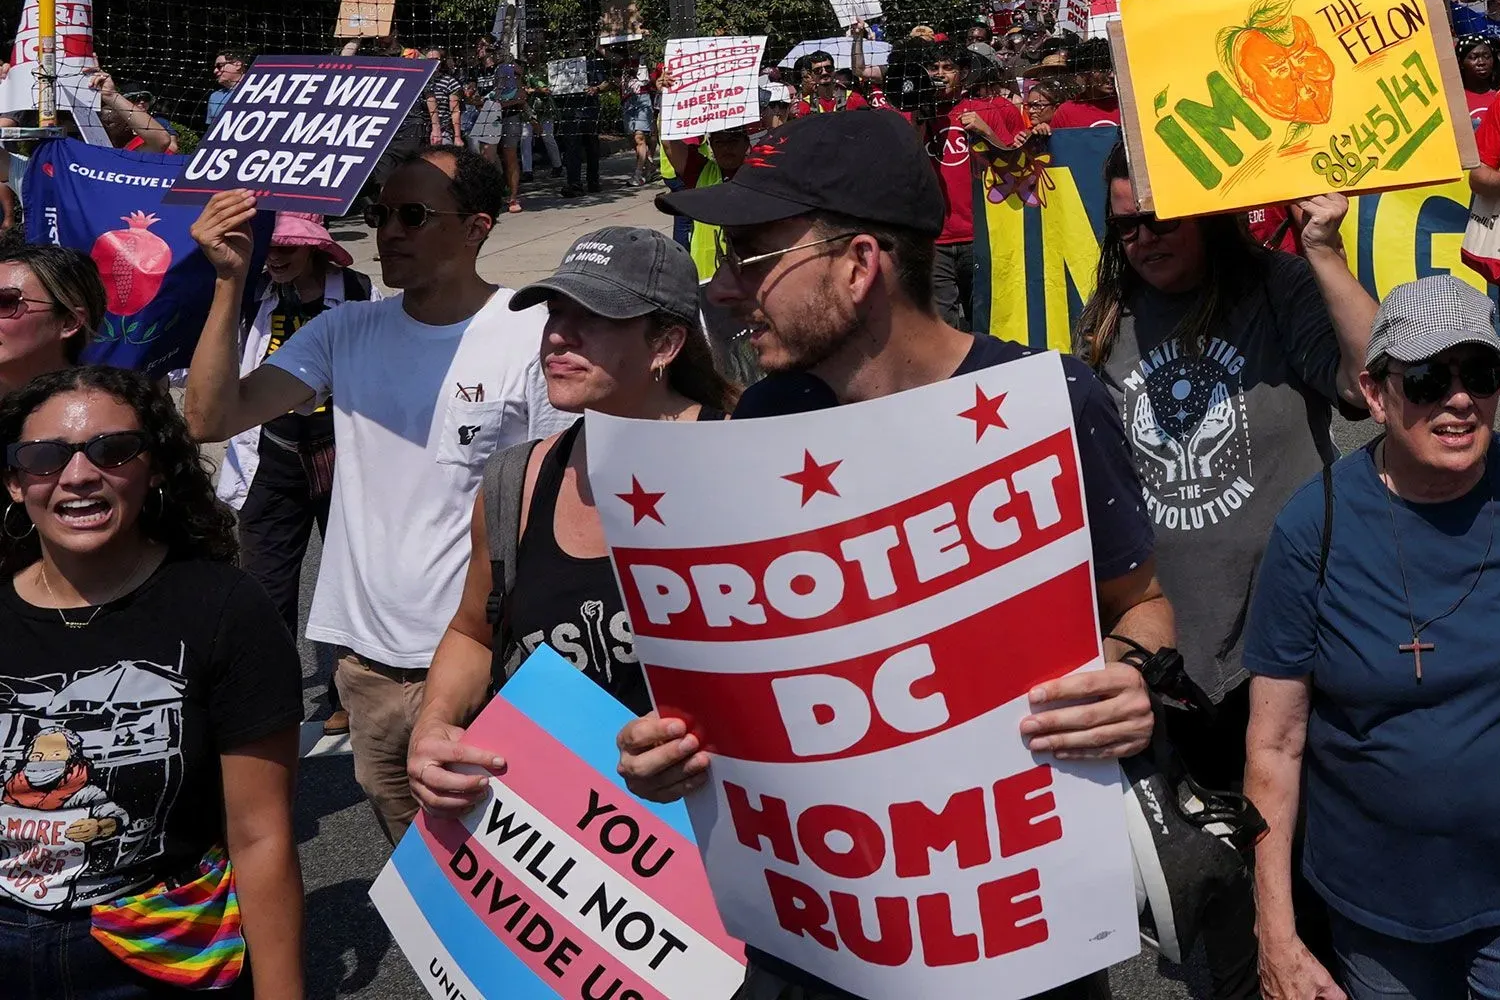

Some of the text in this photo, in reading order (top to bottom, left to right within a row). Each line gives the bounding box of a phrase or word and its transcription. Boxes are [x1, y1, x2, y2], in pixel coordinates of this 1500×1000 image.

[1067, 10, 1087, 31] RUL
[669, 44, 760, 69] TENEMOS
[232, 73, 406, 110] HATE WILL
[677, 85, 745, 111] LIBERTAD
[207, 110, 391, 149] NOT MAKE
[675, 105, 746, 129] SEGURIDAD
[68, 162, 158, 188] COLLECTIVE
[184, 148, 366, 189] US GREAT
[1178, 483, 1201, 500] THE
[628, 453, 1064, 629] PROTECT
[771, 642, 950, 757] DC
[6, 816, 67, 847] MORE
[575, 788, 676, 878] YOU
[721, 763, 1064, 880] HOME
[485, 797, 689, 971] WILL NOT
[448, 842, 584, 979] DIVIDE
[763, 867, 1050, 968] RULE
